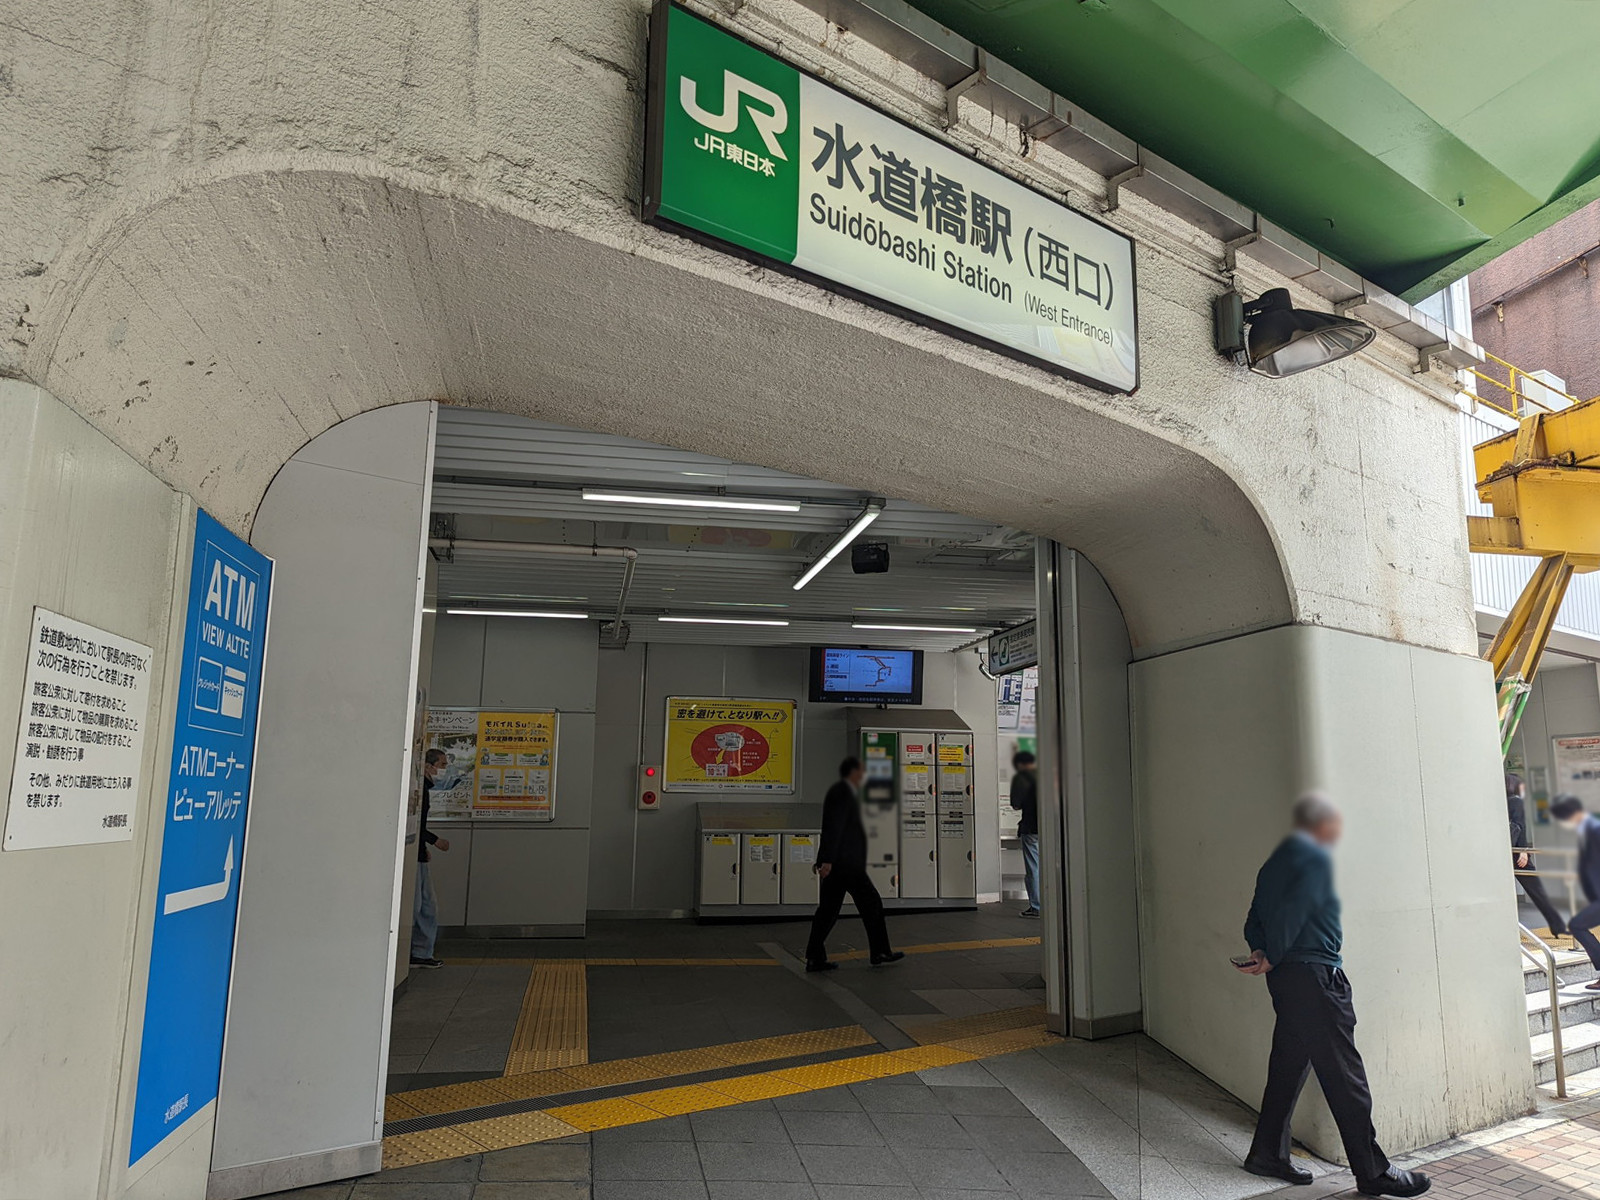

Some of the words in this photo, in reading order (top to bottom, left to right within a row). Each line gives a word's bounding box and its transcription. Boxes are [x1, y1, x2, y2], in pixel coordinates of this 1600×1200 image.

[680, 69, 788, 161] JR
[694, 132, 776, 177] JR東日本
[810, 192, 936, 272] Suidōbashi
[943, 250, 1013, 304] Station
[1024, 290, 1058, 324] (West
[1061, 307, 1114, 348] Entrance)
[204, 558, 256, 632] ATM
[40, 625, 148, 673] 鉄道敷地内において駅長の許可なく
[202, 620, 225, 649] VIEW
[225, 633, 250, 660] ALTTE
[37, 649, 138, 690] 次の行為を行うことを禁じます。
[30, 701, 139, 732] 旅客公衆に対して物品の購買を求めること
[33, 681, 127, 713] 旅客公衆に対して寄付を求めること
[29, 772, 132, 790] その他、みだりに鉄道用地に立ち入る事
[178, 745, 245, 780] ATMコーナー
[26, 793, 63, 809] を禁じます。
[173, 787, 242, 822] ビューアルッテ
